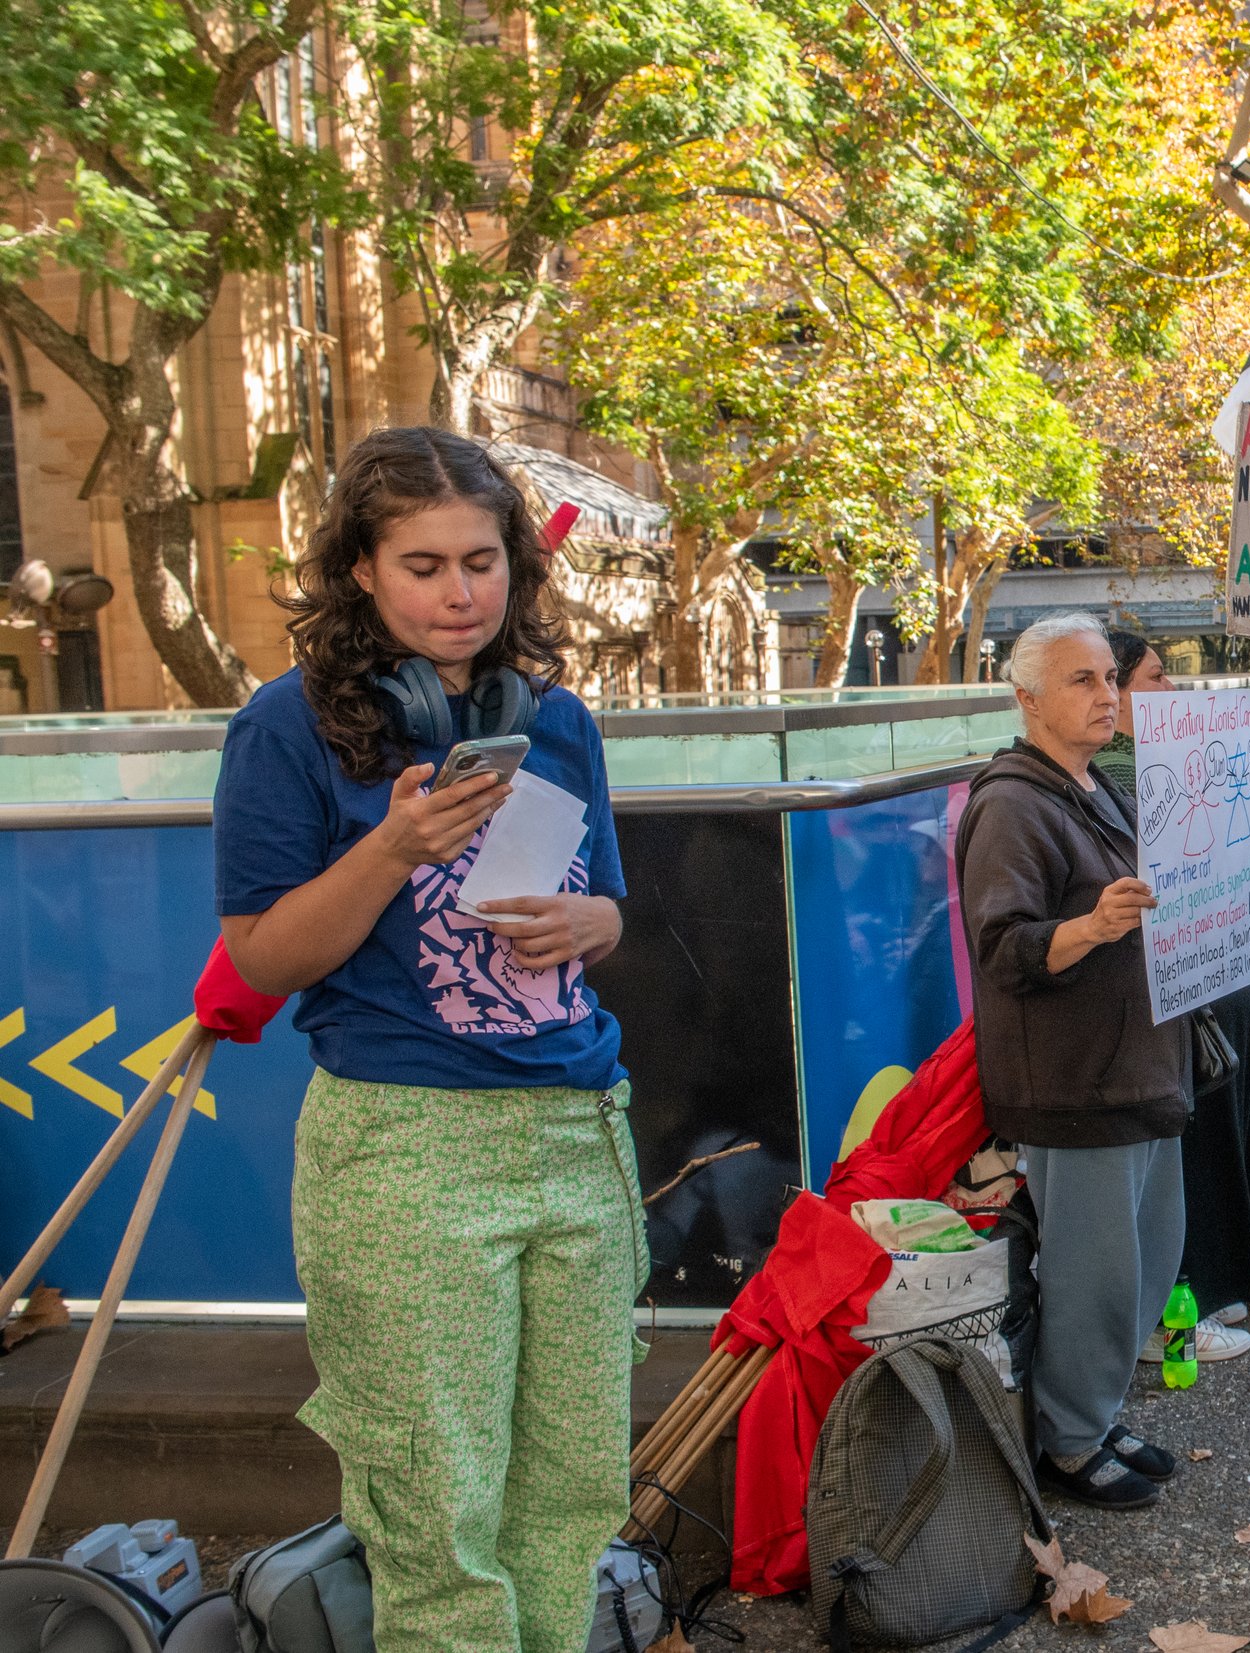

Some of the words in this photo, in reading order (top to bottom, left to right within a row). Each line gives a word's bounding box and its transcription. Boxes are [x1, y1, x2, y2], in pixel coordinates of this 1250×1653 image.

[1139, 703, 1166, 744] 21st
[1170, 700, 1205, 745] Century
[1208, 694, 1238, 732] Zionist
[1143, 801, 1167, 836] them
[1164, 775, 1177, 804] all
[1181, 861, 1197, 884] the
[1199, 854, 1212, 878] rat
[1151, 887, 1184, 925] Zionist
[1188, 874, 1225, 920] genocide
[1152, 927, 1176, 957] Have
[1177, 919, 1192, 945] his
[1194, 913, 1214, 945] paws
[1216, 909, 1227, 929] on
[1154, 949, 1199, 987] Palestinian
[1159, 981, 1202, 1017] Palestinian
[1229, 957, 1245, 982] BBQ
[451, 1020, 537, 1036] CLASS
